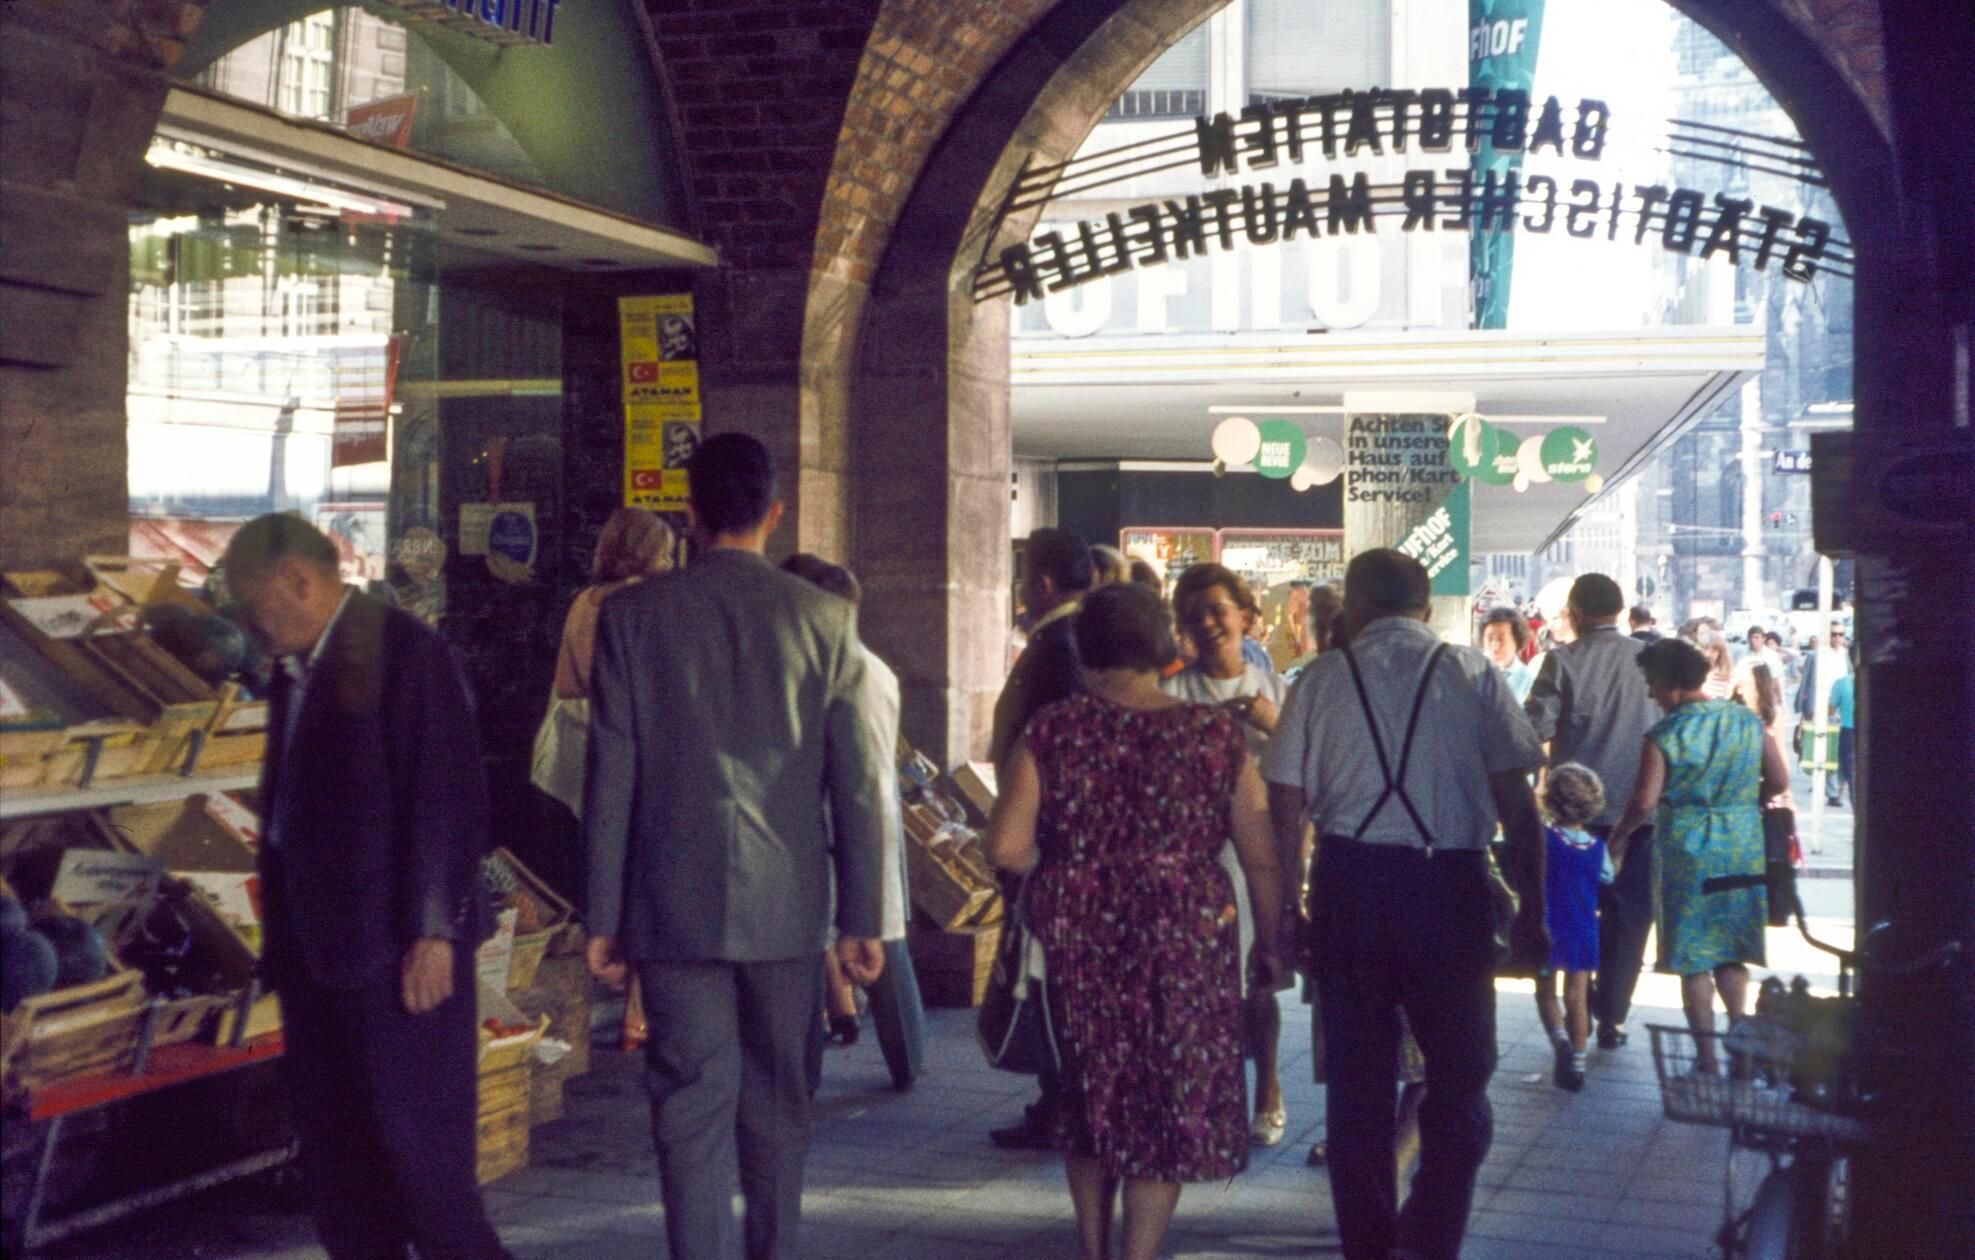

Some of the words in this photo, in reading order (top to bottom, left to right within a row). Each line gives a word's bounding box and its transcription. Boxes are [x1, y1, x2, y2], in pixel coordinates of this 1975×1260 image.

[1349, 416, 1425, 433] Achten
[1347, 434, 1369, 449] in
[1347, 450, 1403, 466] Haus
[1775, 450, 1795, 469] An
[1796, 451, 1813, 470] de
[1547, 461, 1592, 475] stern
[1347, 485, 1431, 502] Service!
